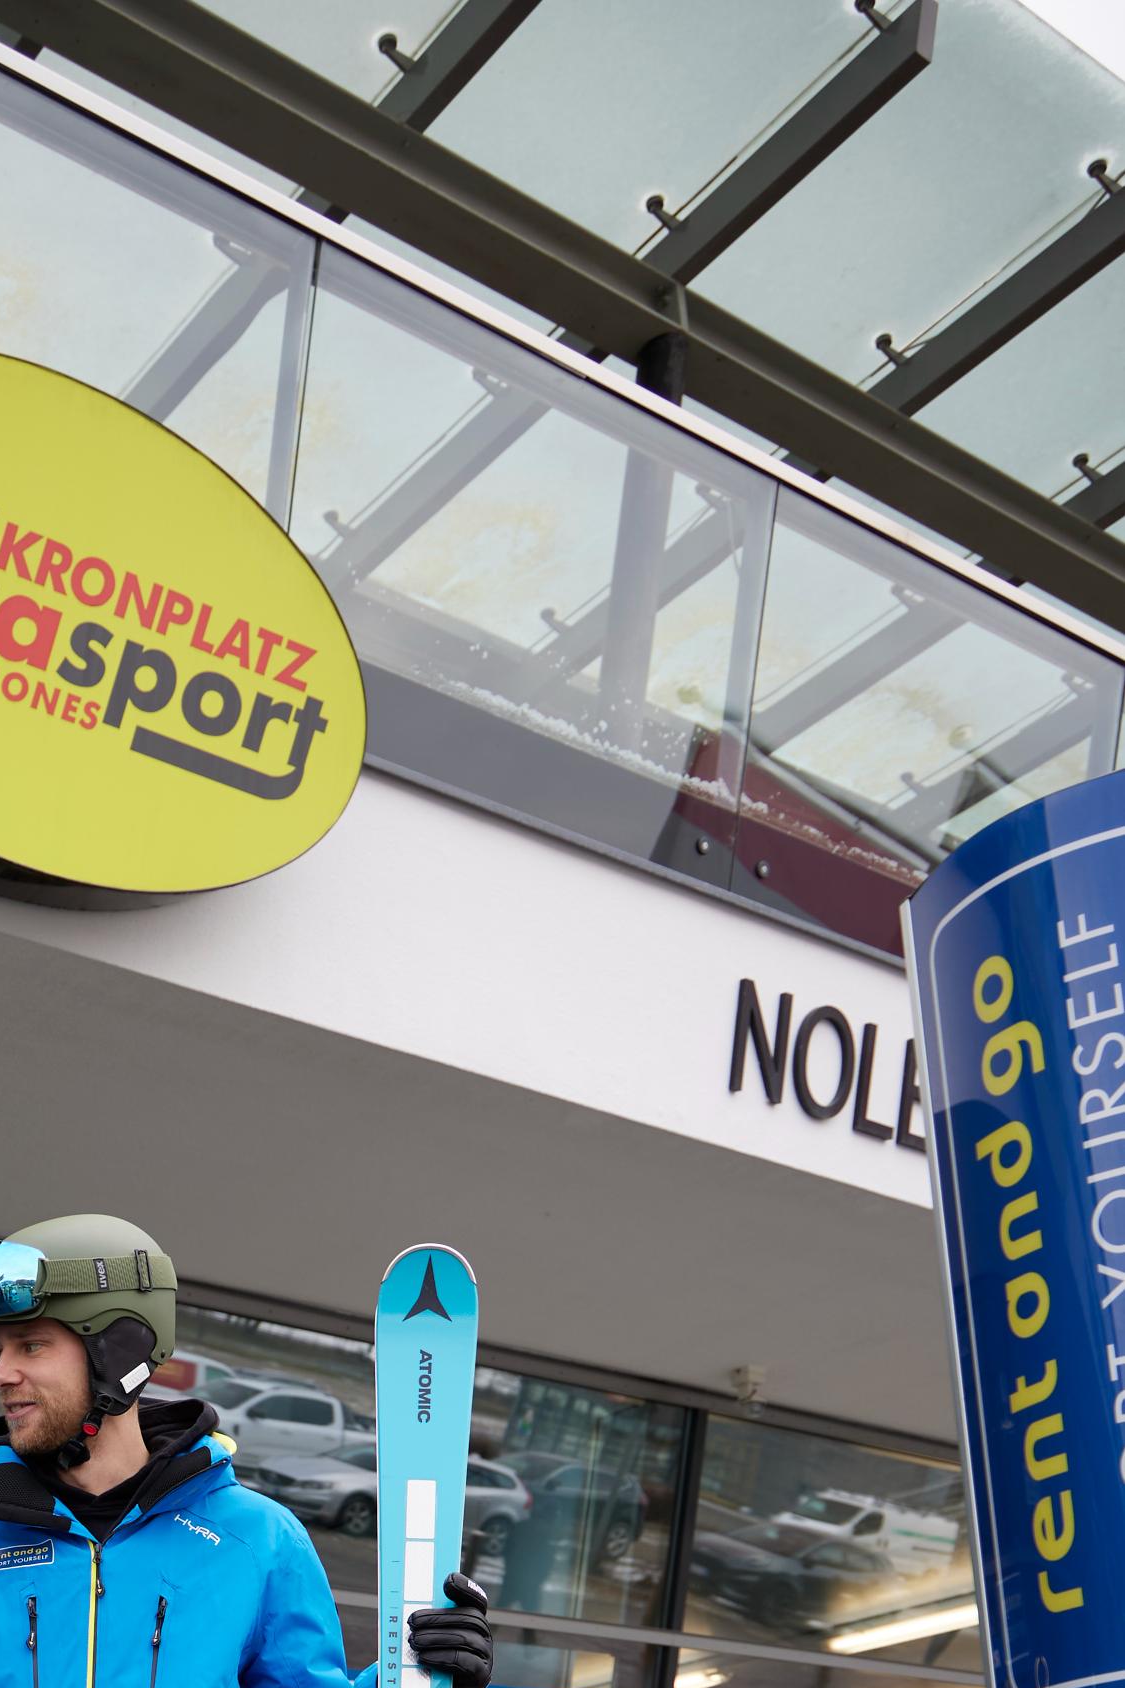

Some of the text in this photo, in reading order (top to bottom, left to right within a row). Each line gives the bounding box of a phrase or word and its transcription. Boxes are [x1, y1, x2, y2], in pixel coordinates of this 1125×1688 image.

[96, 1260, 107, 1288] uvex
[973, 955, 1085, 1615] rent and go
[418, 1348, 432, 1424] ATOMIC
[174, 1514, 221, 1546] HYRA
[13, 1548, 34, 1556] and
[35, 1546, 48, 1555] go
[13, 1554, 48, 1564] YOURSELF
